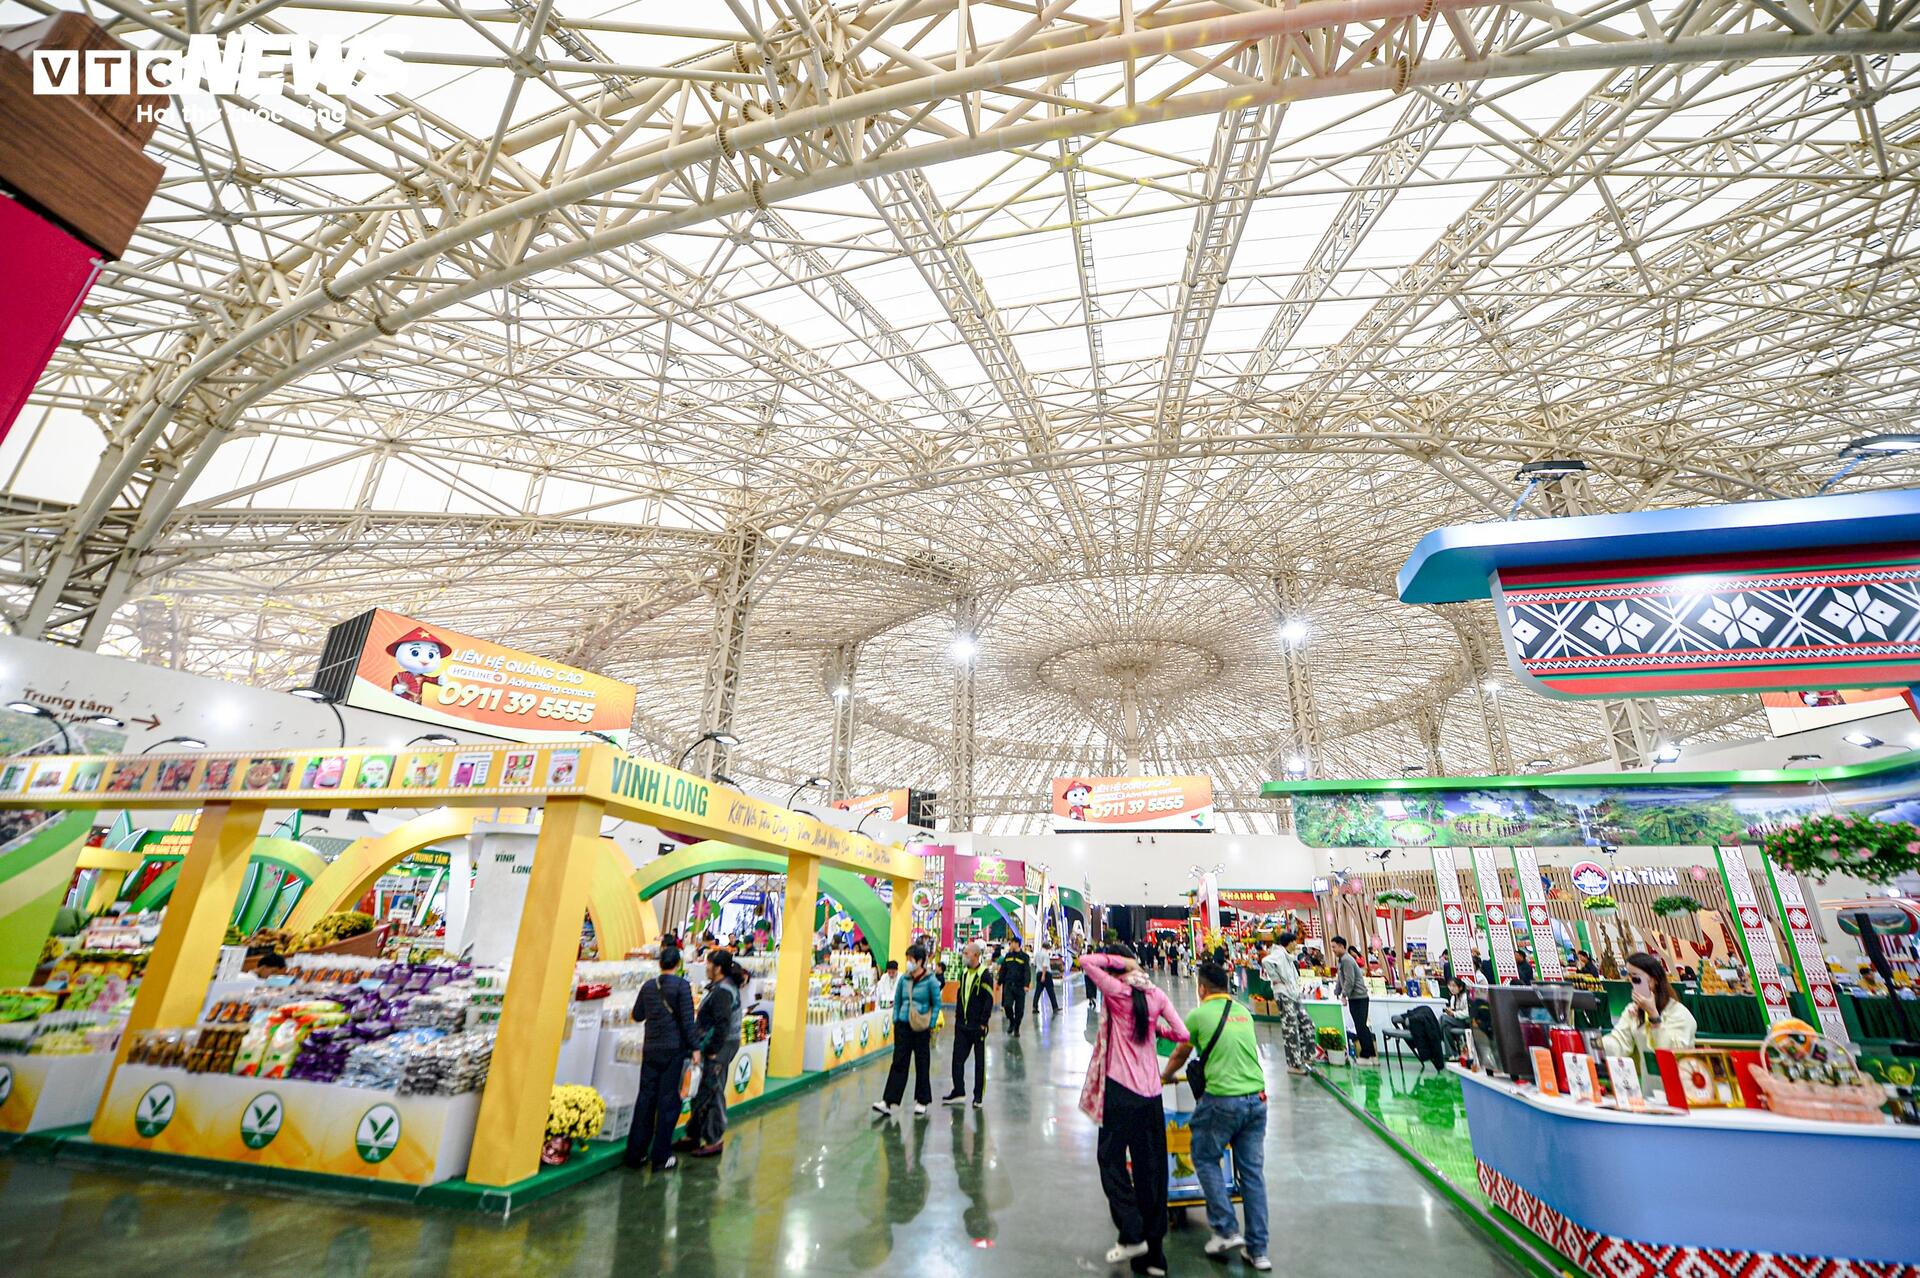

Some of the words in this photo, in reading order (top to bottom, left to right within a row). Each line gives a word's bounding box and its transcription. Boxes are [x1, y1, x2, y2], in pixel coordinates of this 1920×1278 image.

[452, 647, 483, 665] LIÊN
[452, 667, 492, 682] HOTLINE
[23, 688, 76, 710] Trung
[80, 700, 113, 715] tâm
[437, 681, 504, 712] 0911
[502, 691, 537, 716] 39
[536, 697, 598, 724] 5555
[611, 755, 661, 805] VĨNH
[662, 775, 709, 817] LONG
[1092, 801, 1126, 819] 0911
[1127, 799, 1146, 815] 39
[1147, 794, 1185, 813] 5555
[1610, 866, 1640, 885] HÀ
[1638, 865, 1680, 886] TĨNH
[1219, 892, 1254, 902] THANH
